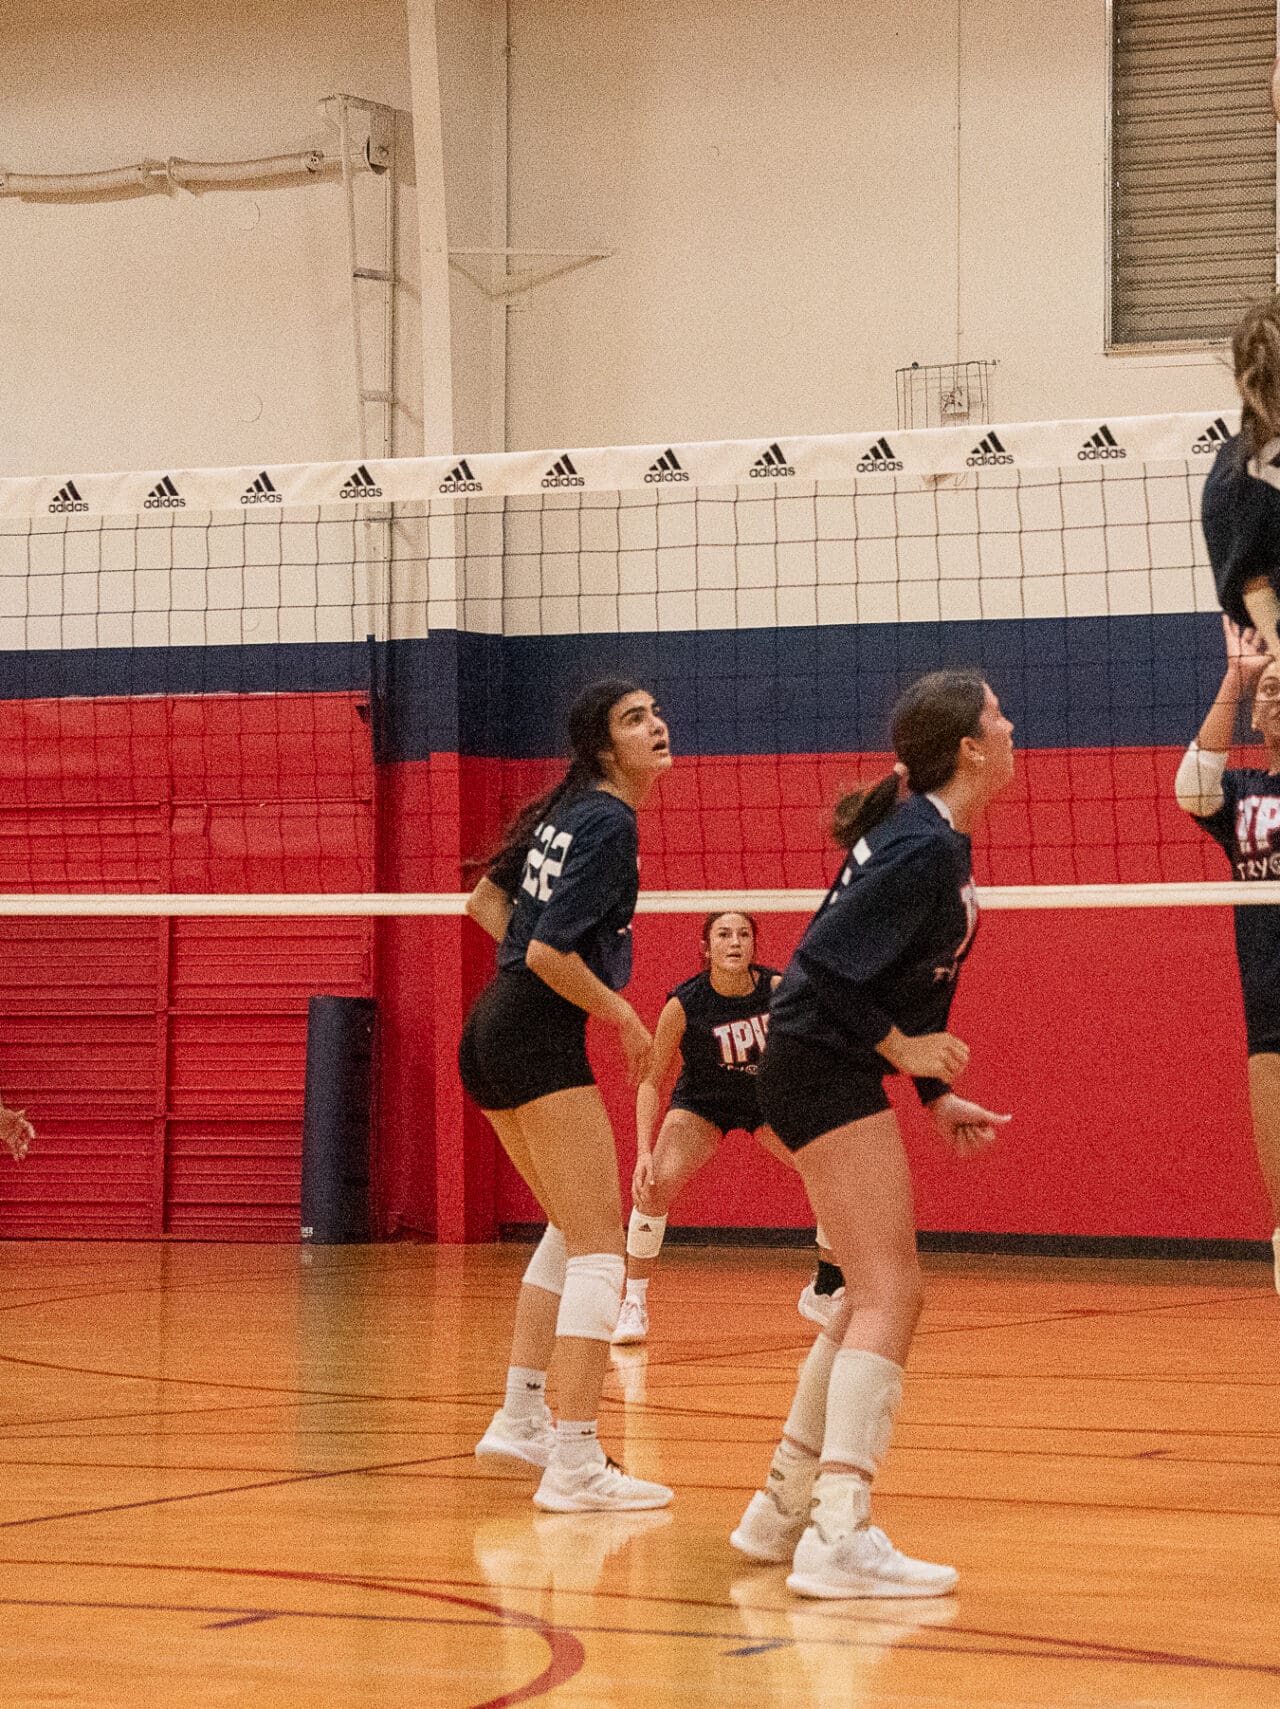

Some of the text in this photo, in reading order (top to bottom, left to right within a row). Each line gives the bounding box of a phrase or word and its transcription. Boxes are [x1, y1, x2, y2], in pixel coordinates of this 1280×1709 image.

[966, 453, 1014, 466] adidas
[1077, 448, 1127, 461] adidas
[749, 464, 795, 477] adidas
[856, 459, 903, 472] adidas
[541, 475, 585, 487] adidas
[644, 470, 690, 483] adidas
[339, 486, 383, 498] adidas
[439, 481, 483, 493] adidas
[144, 497, 186, 509] adidas
[240, 492, 282, 504] adidas
[48, 501, 89, 513] adidas
